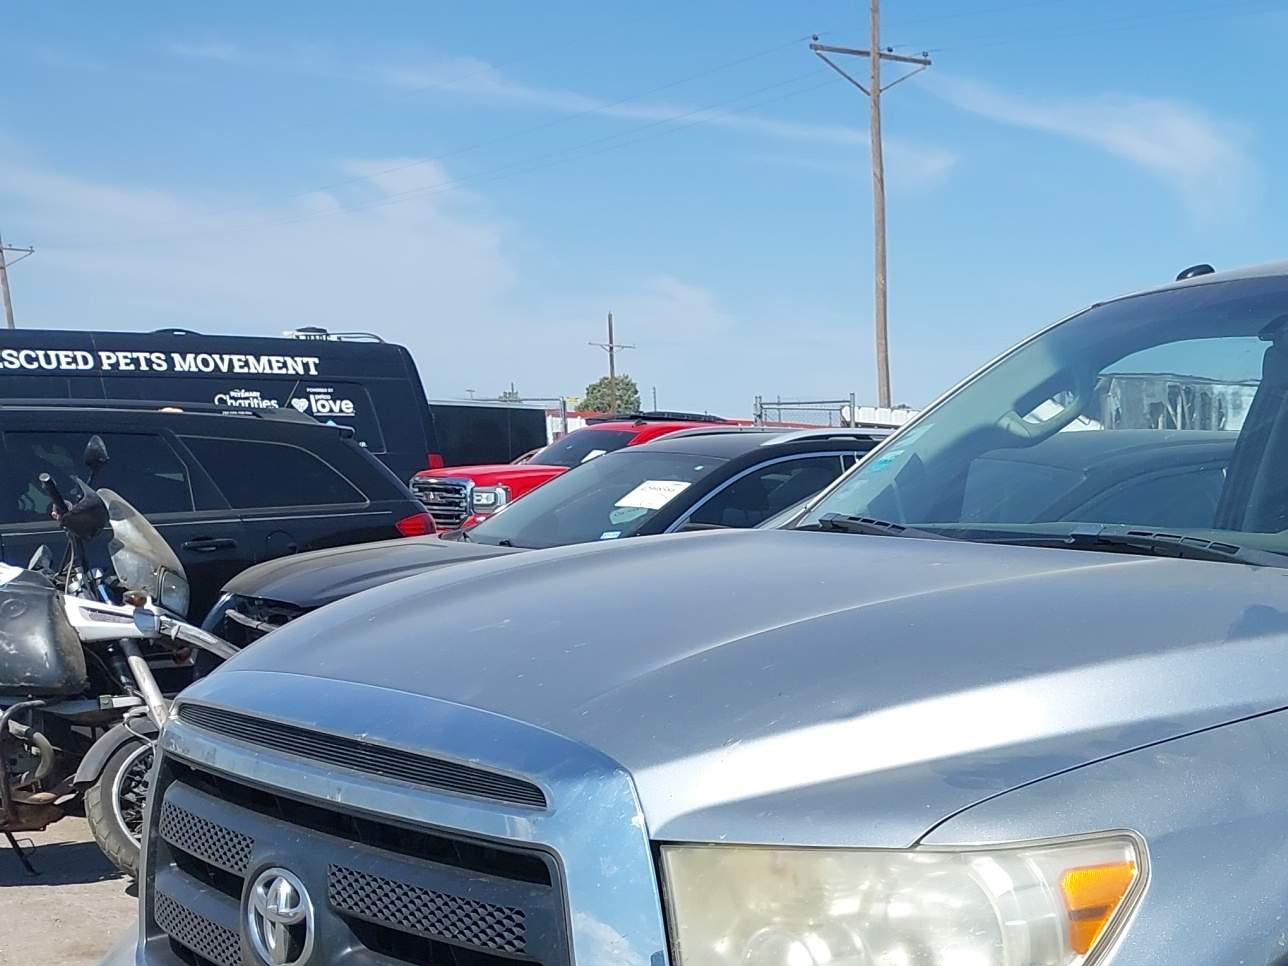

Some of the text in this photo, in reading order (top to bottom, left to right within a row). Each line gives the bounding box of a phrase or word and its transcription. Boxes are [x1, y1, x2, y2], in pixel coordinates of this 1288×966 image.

[0, 349, 320, 376] SCUED PETS MOVEMENT
[214, 393, 279, 409] Charities
[309, 394, 354, 413] love
